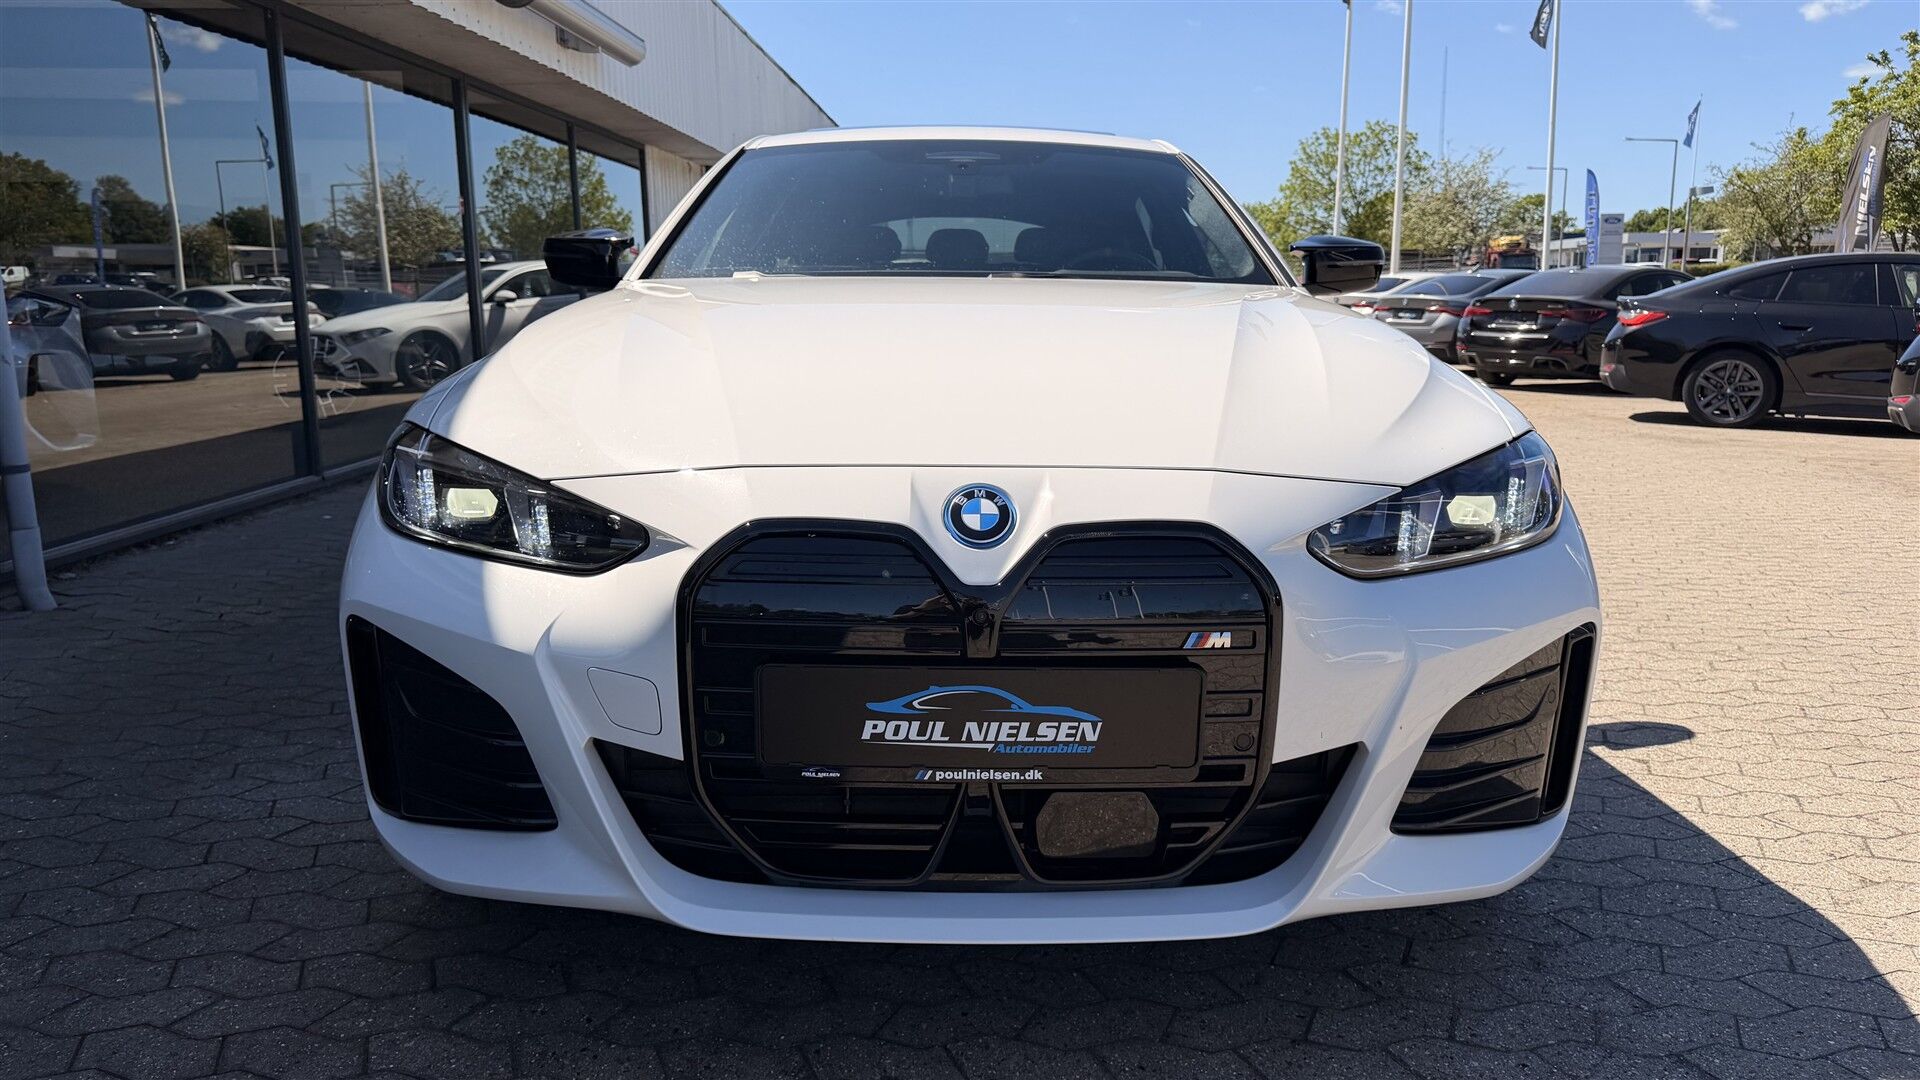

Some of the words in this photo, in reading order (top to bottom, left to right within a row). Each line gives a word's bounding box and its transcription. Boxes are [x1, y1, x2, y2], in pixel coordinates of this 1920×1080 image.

[954, 489, 1006, 507] BMW
[861, 720, 950, 741] POUL
[961, 721, 1103, 742] NIELSEN
[993, 743, 1096, 754] Automobiler
[935, 768, 1043, 781] poulnielsen.dk
